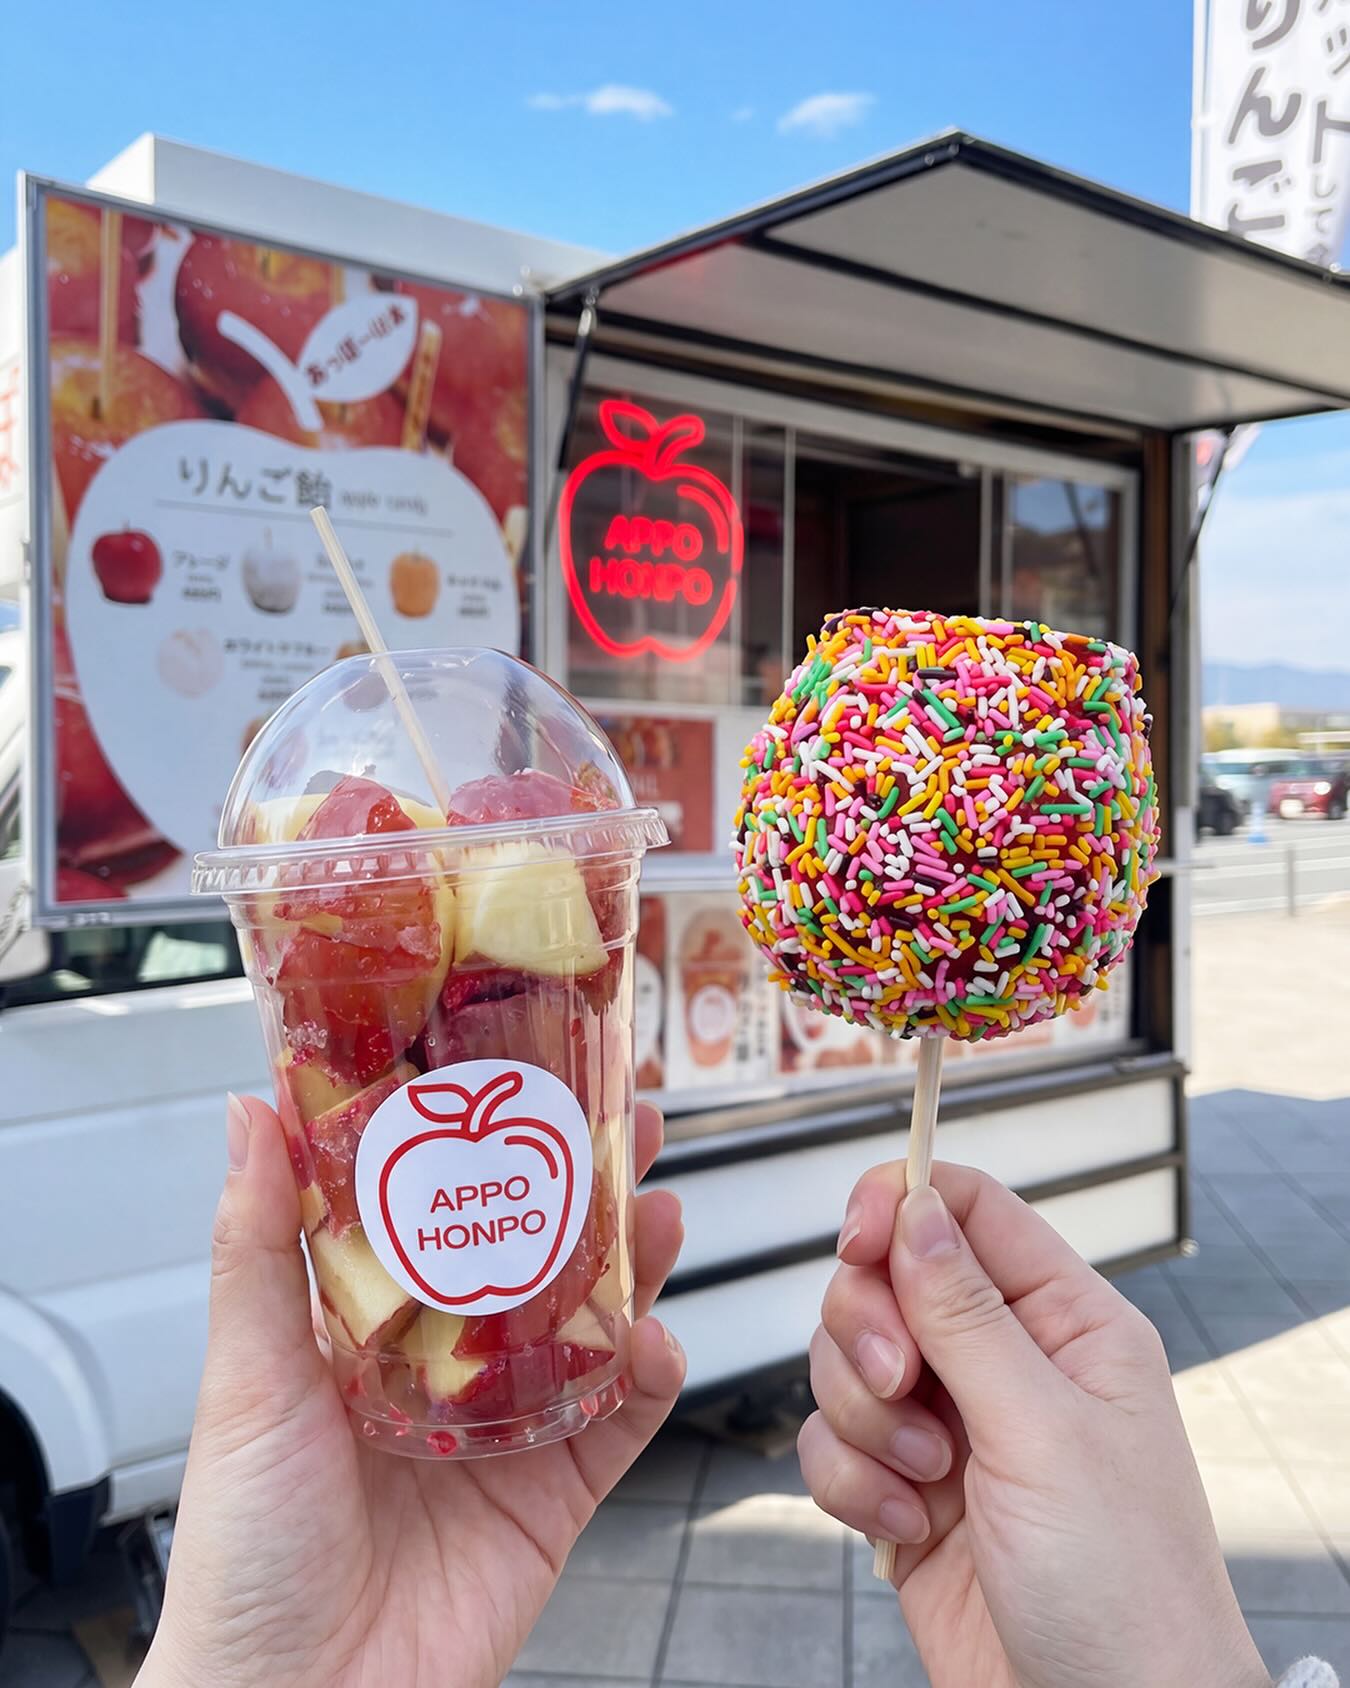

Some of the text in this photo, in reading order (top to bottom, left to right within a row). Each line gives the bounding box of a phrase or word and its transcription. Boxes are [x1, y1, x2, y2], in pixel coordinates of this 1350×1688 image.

[178, 456, 332, 510] りんご飴
[604, 515, 703, 561] APPO
[589, 557, 713, 605] HONPO
[430, 1175, 530, 1213] APPO
[417, 1209, 547, 1251] HONPO
